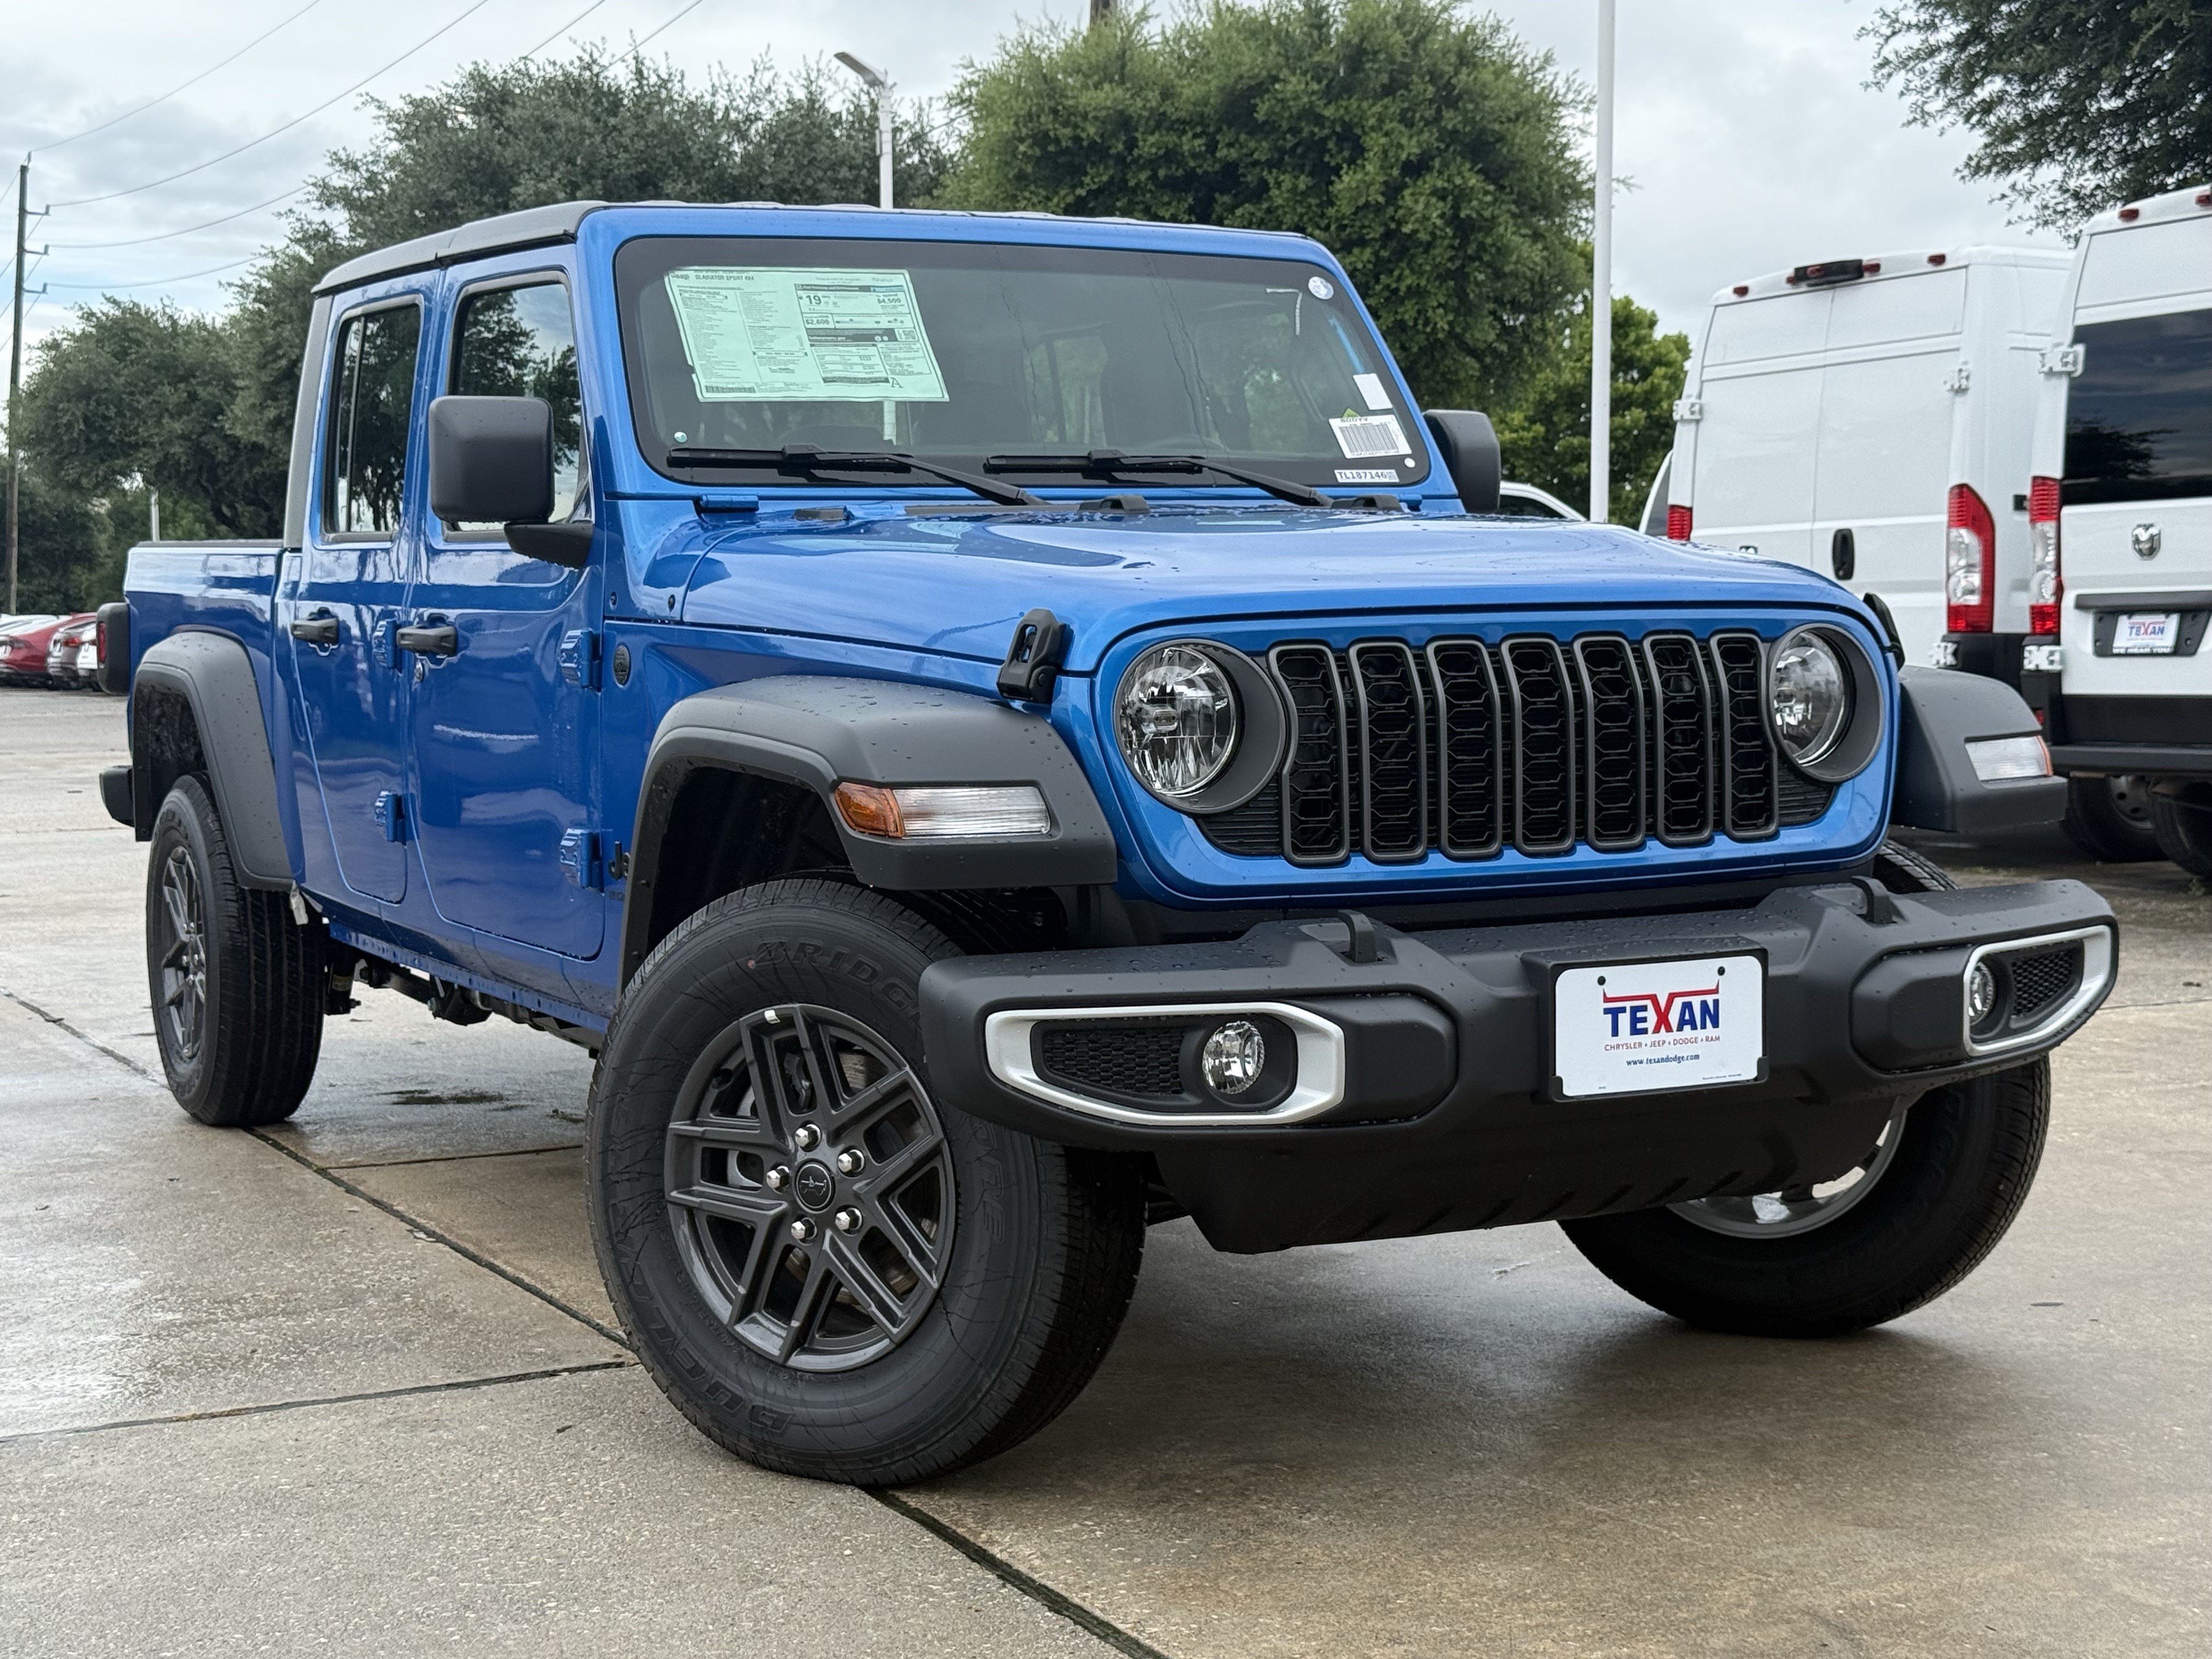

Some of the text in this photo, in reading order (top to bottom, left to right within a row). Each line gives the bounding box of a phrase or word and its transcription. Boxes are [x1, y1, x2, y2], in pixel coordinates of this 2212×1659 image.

[805, 295, 821, 304] 19
[2128, 622, 2166, 636] TEXAN
[1603, 989, 1719, 1037] TEXAN
[1604, 1042, 1643, 1052] CHRYSLER
[1649, 1040, 1666, 1048] JEEP
[1673, 1036, 1699, 1046] DODGE
[1626, 1054, 1700, 1066] www.texandodge.com
